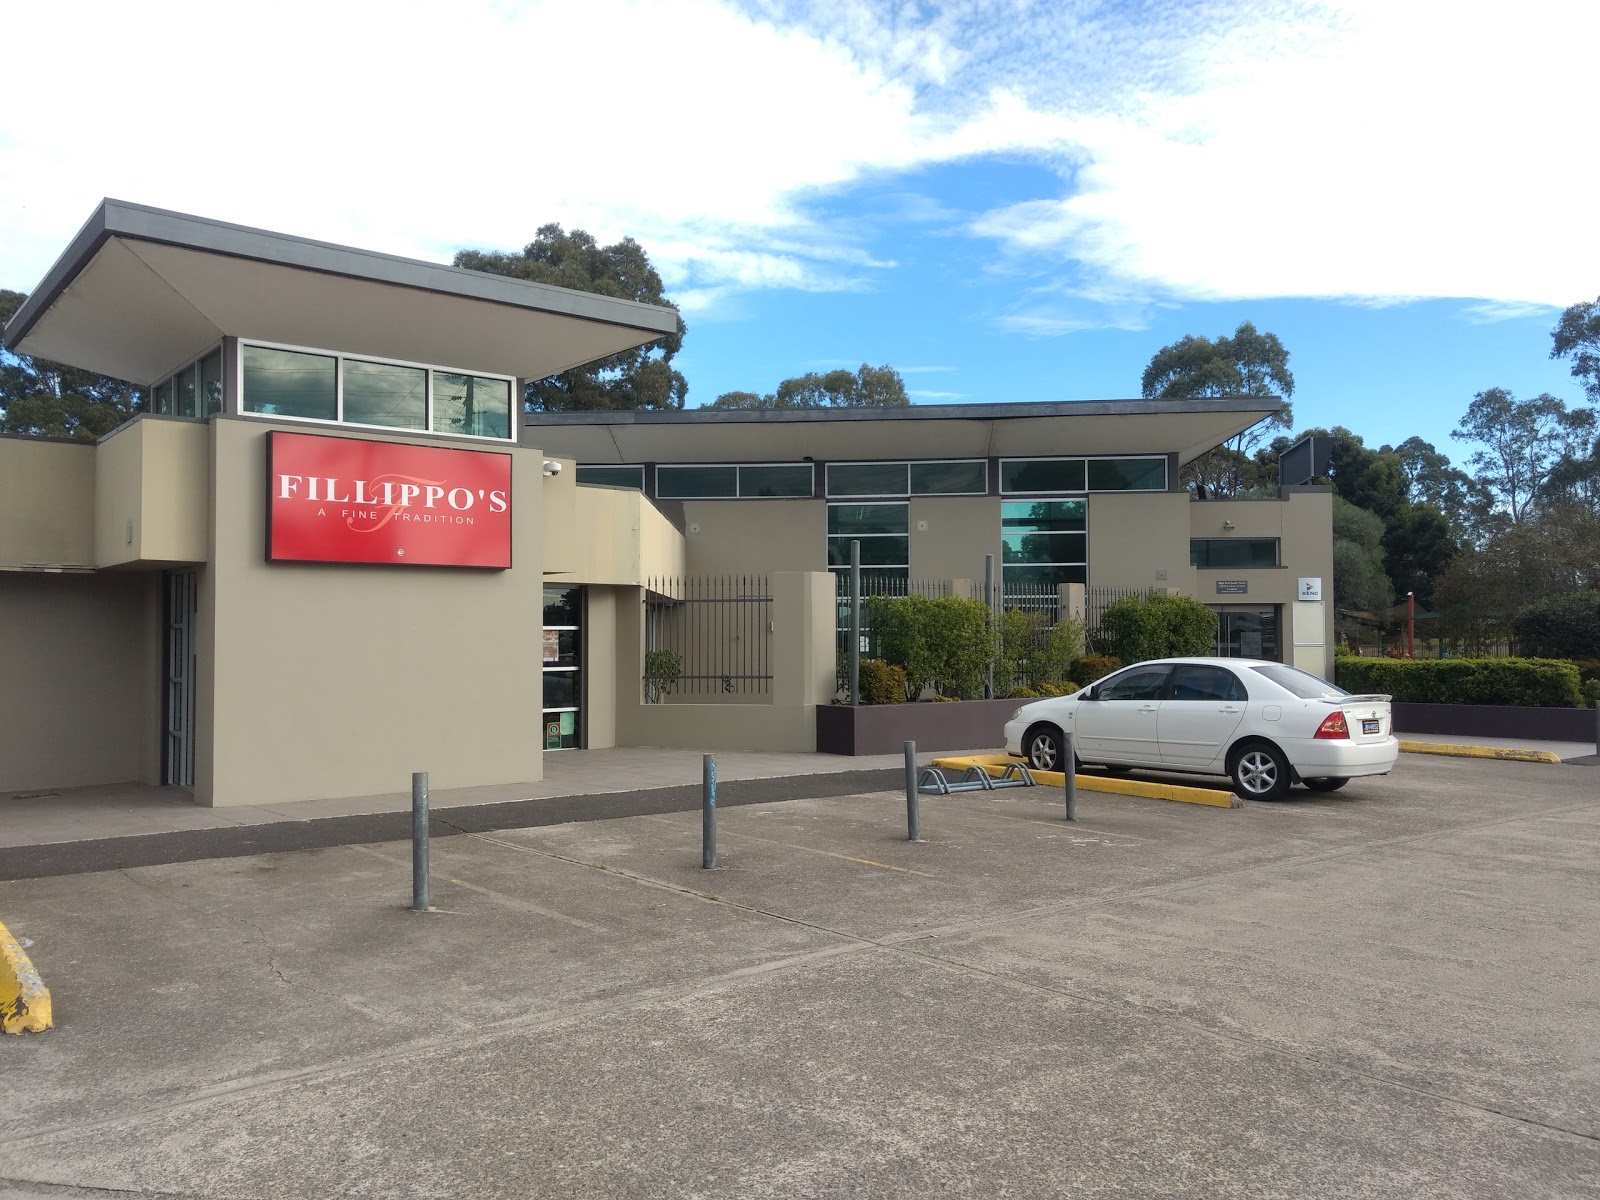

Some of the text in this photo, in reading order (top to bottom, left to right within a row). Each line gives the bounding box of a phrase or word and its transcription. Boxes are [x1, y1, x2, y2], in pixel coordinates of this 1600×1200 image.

[277, 474, 507, 513] FILLIPPO'S
[317, 508, 474, 525] A FINE TRADITION
